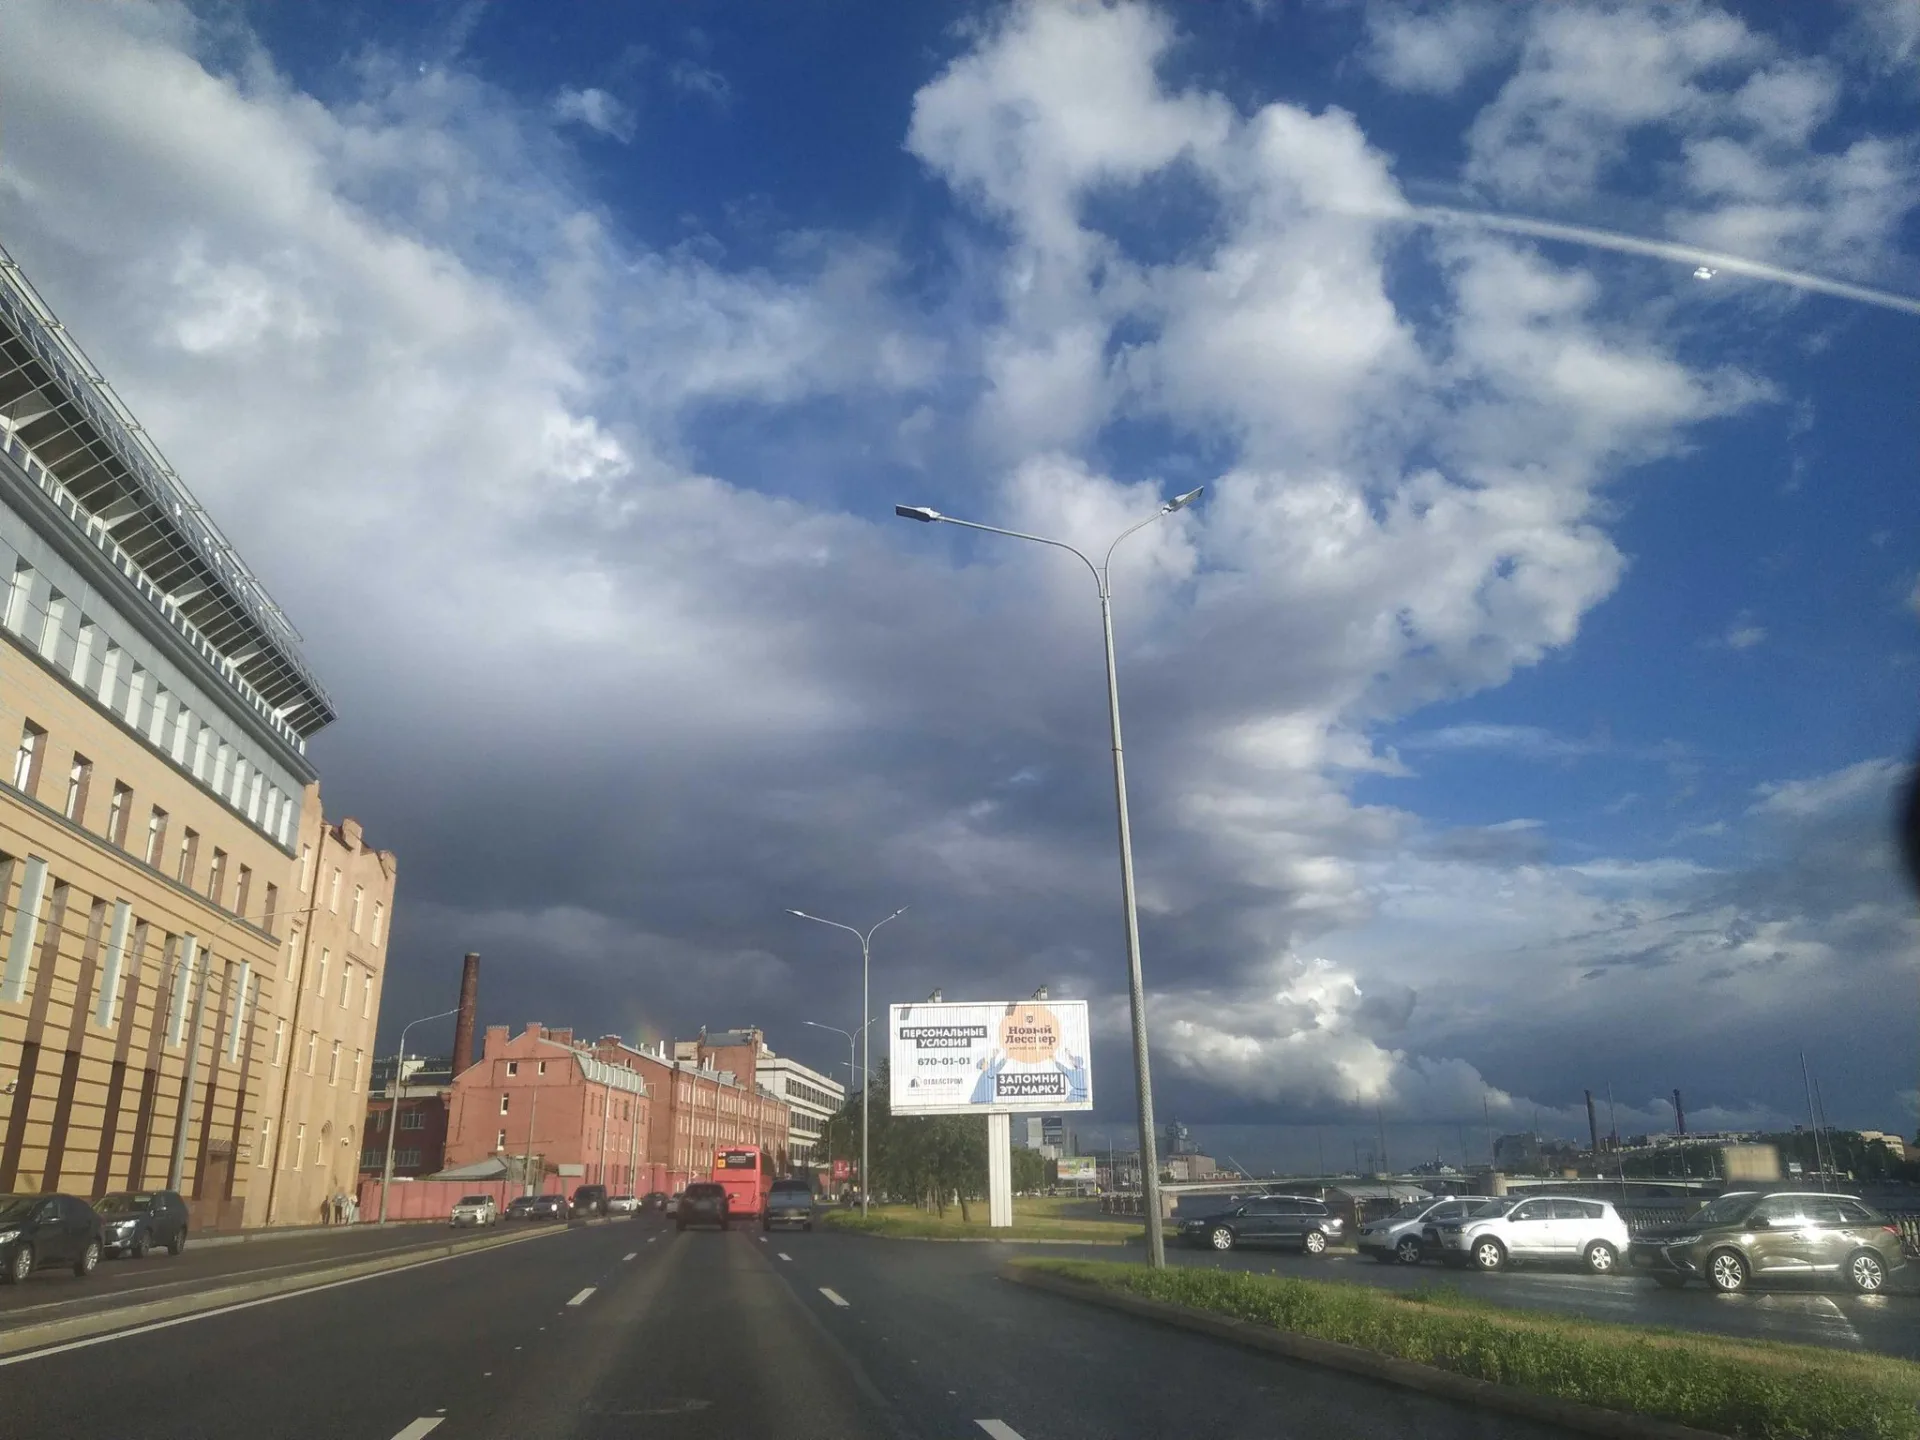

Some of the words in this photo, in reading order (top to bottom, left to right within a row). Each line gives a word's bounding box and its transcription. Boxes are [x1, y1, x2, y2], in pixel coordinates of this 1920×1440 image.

[903, 1028, 984, 1038] ПЕРСОНАЛЬНЫЕ
[1008, 1025, 1052, 1034] Новый
[919, 1039, 967, 1047] УСЛОВИЯ
[917, 1057, 971, 1066] 670-01-01
[999, 1074, 1059, 1084] ЗАПОМНИ
[999, 1085, 1020, 1095] ЭТУ
